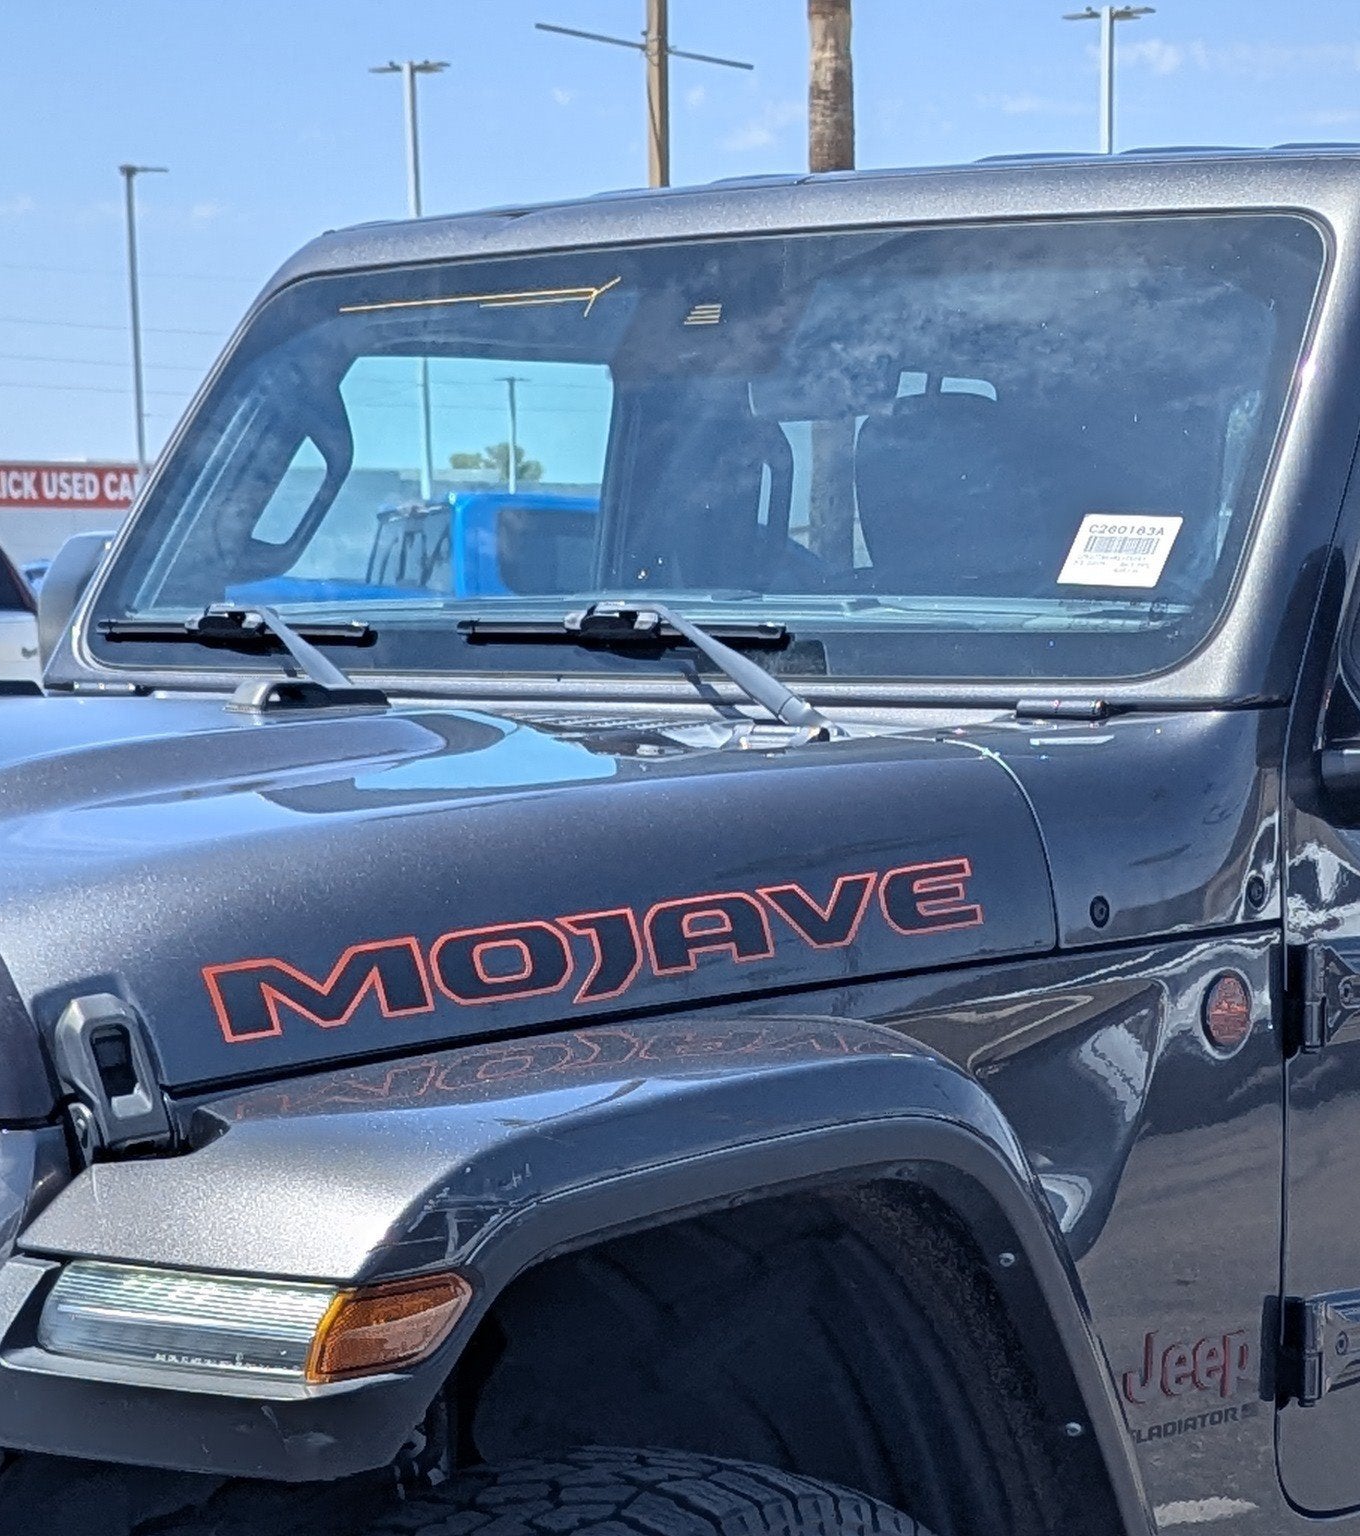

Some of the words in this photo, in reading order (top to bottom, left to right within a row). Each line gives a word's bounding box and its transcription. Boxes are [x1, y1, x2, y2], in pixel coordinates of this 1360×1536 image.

[42, 473, 100, 500] USED
[202, 857, 983, 1044] MOJAVE
[1122, 1329, 1252, 1405] Jeep
